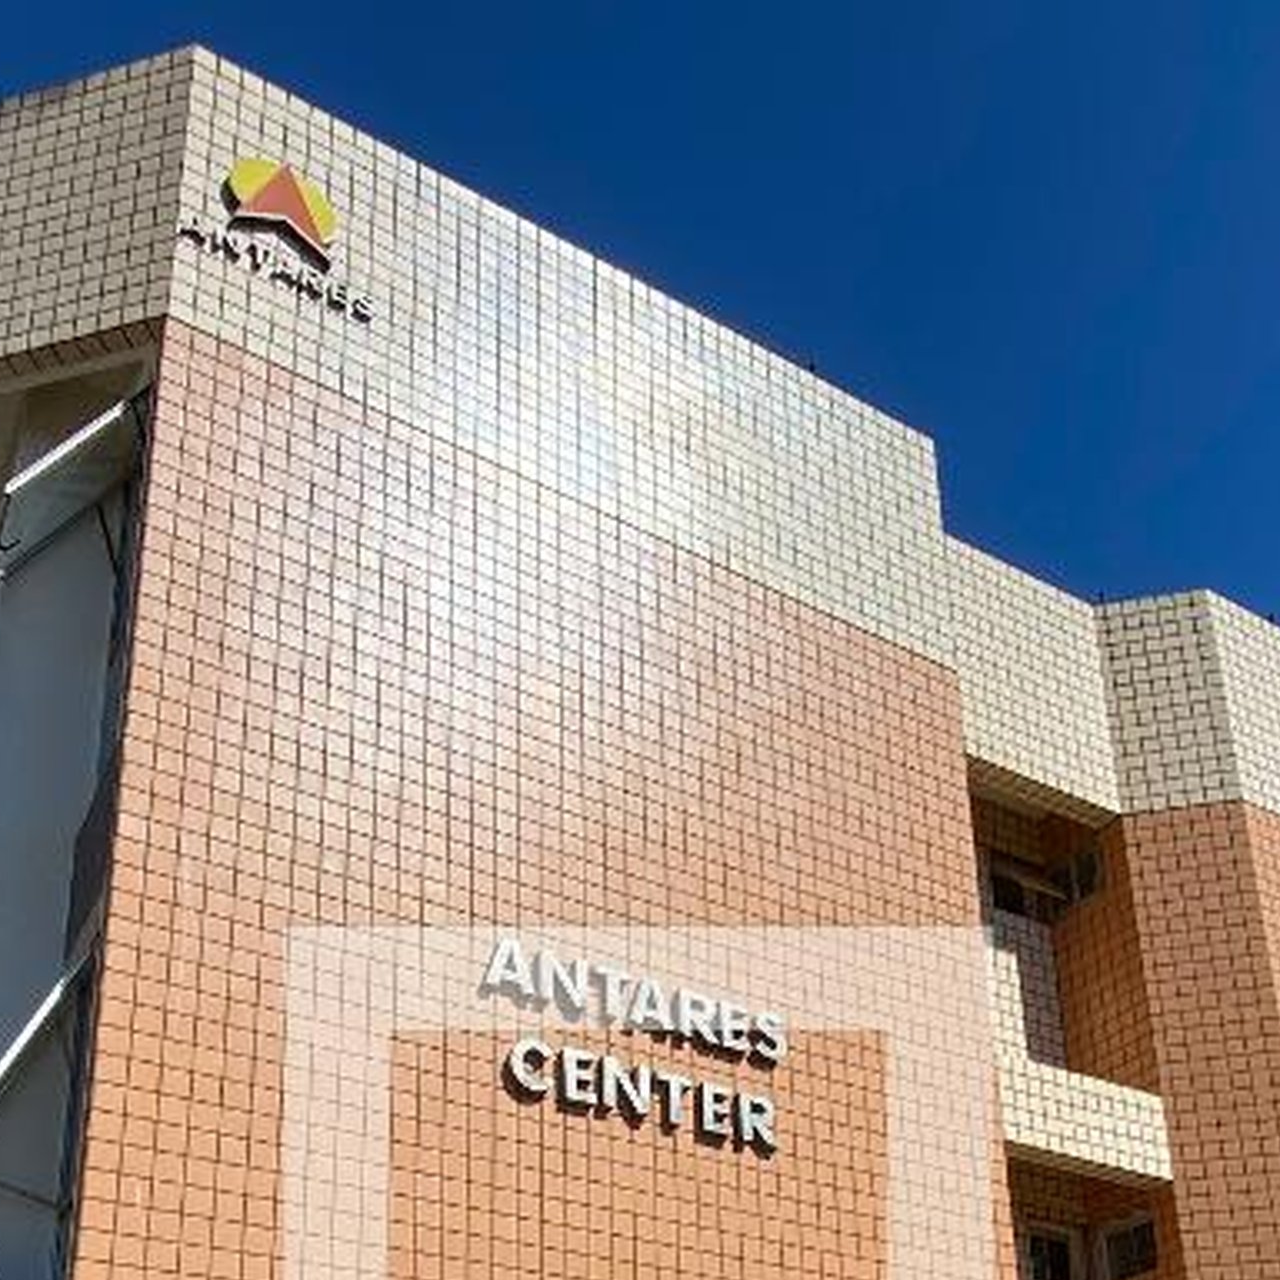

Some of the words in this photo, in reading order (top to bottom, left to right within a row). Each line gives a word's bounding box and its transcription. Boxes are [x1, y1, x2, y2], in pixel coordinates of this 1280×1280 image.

[177, 216, 375, 323] ANTARES
[478, 937, 790, 1069] ANTARES
[502, 1036, 780, 1157] CENTER
